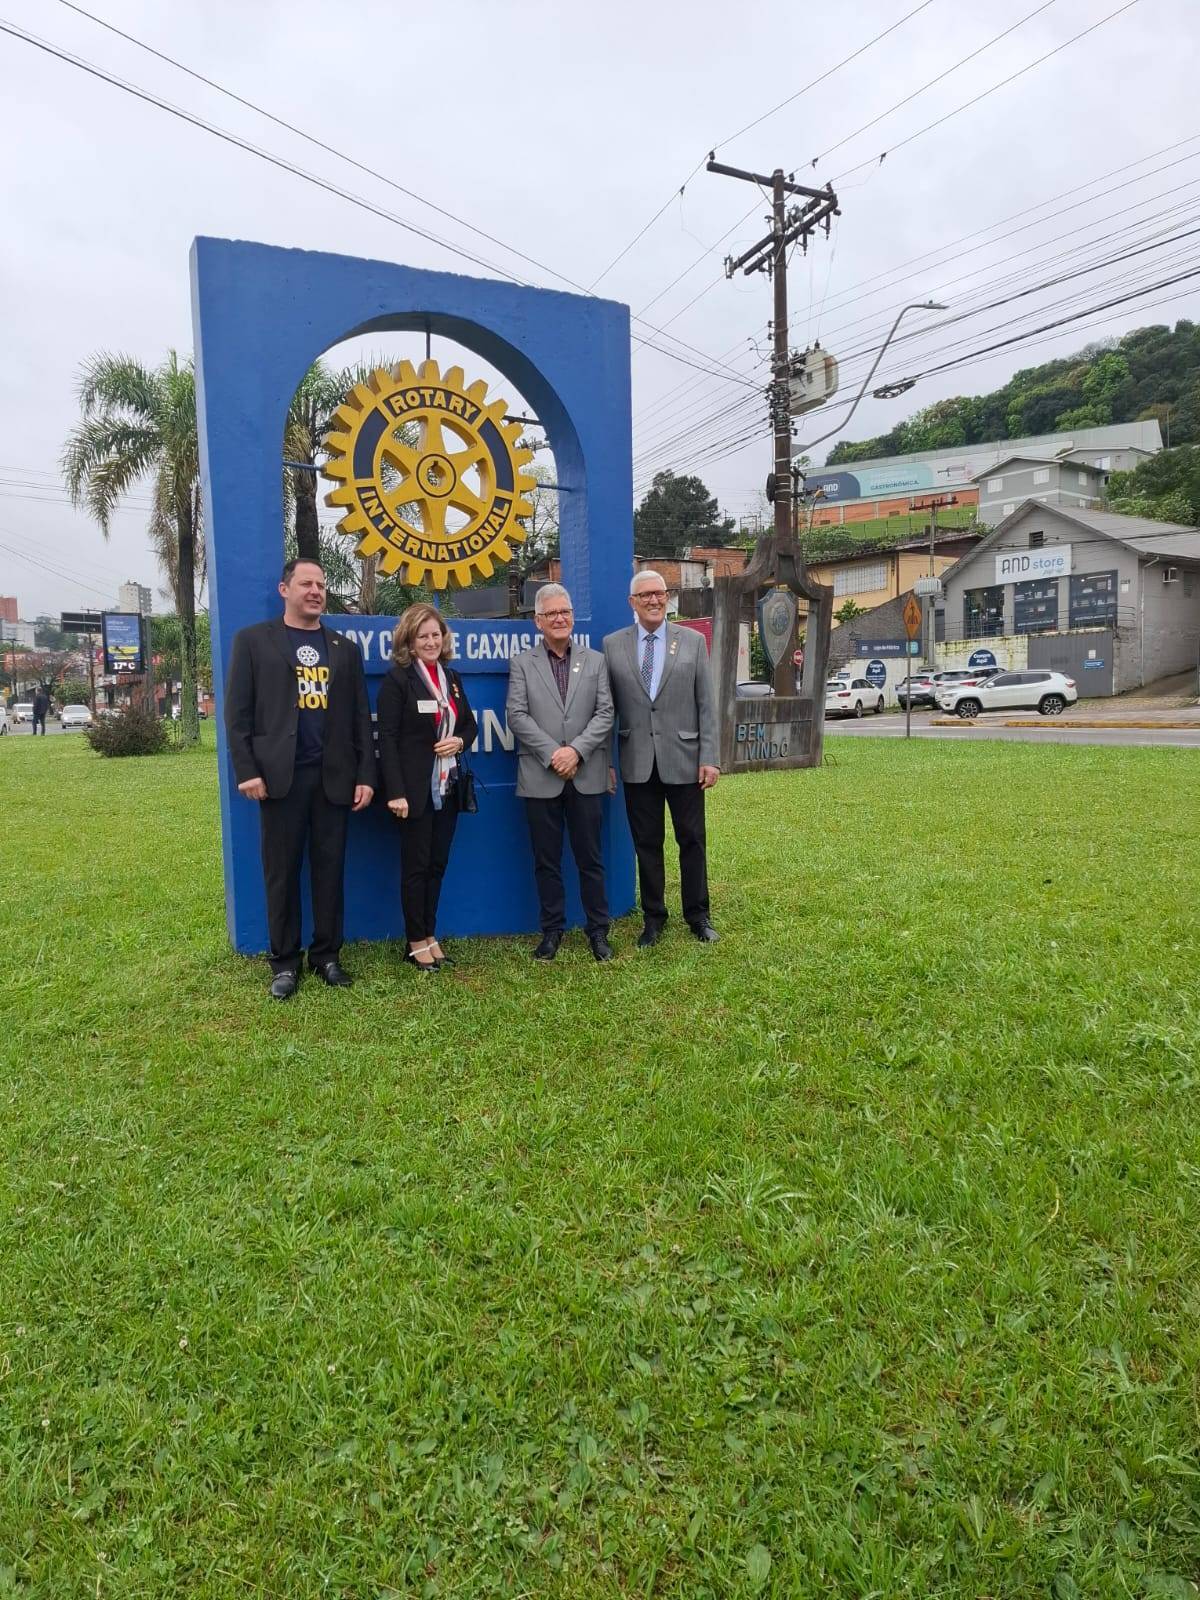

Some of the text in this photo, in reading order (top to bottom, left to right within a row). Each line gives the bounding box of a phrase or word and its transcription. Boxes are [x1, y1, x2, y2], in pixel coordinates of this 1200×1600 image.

[389, 388, 477, 419] ROTARY
[359, 489, 511, 562] INTERNATIONAL
[1002, 556, 1030, 574] AND
[1032, 557, 1065, 570] store
[466, 633, 532, 660] CAXIAS
[736, 723, 767, 742] BEM
[745, 740, 790, 761] VINDO
